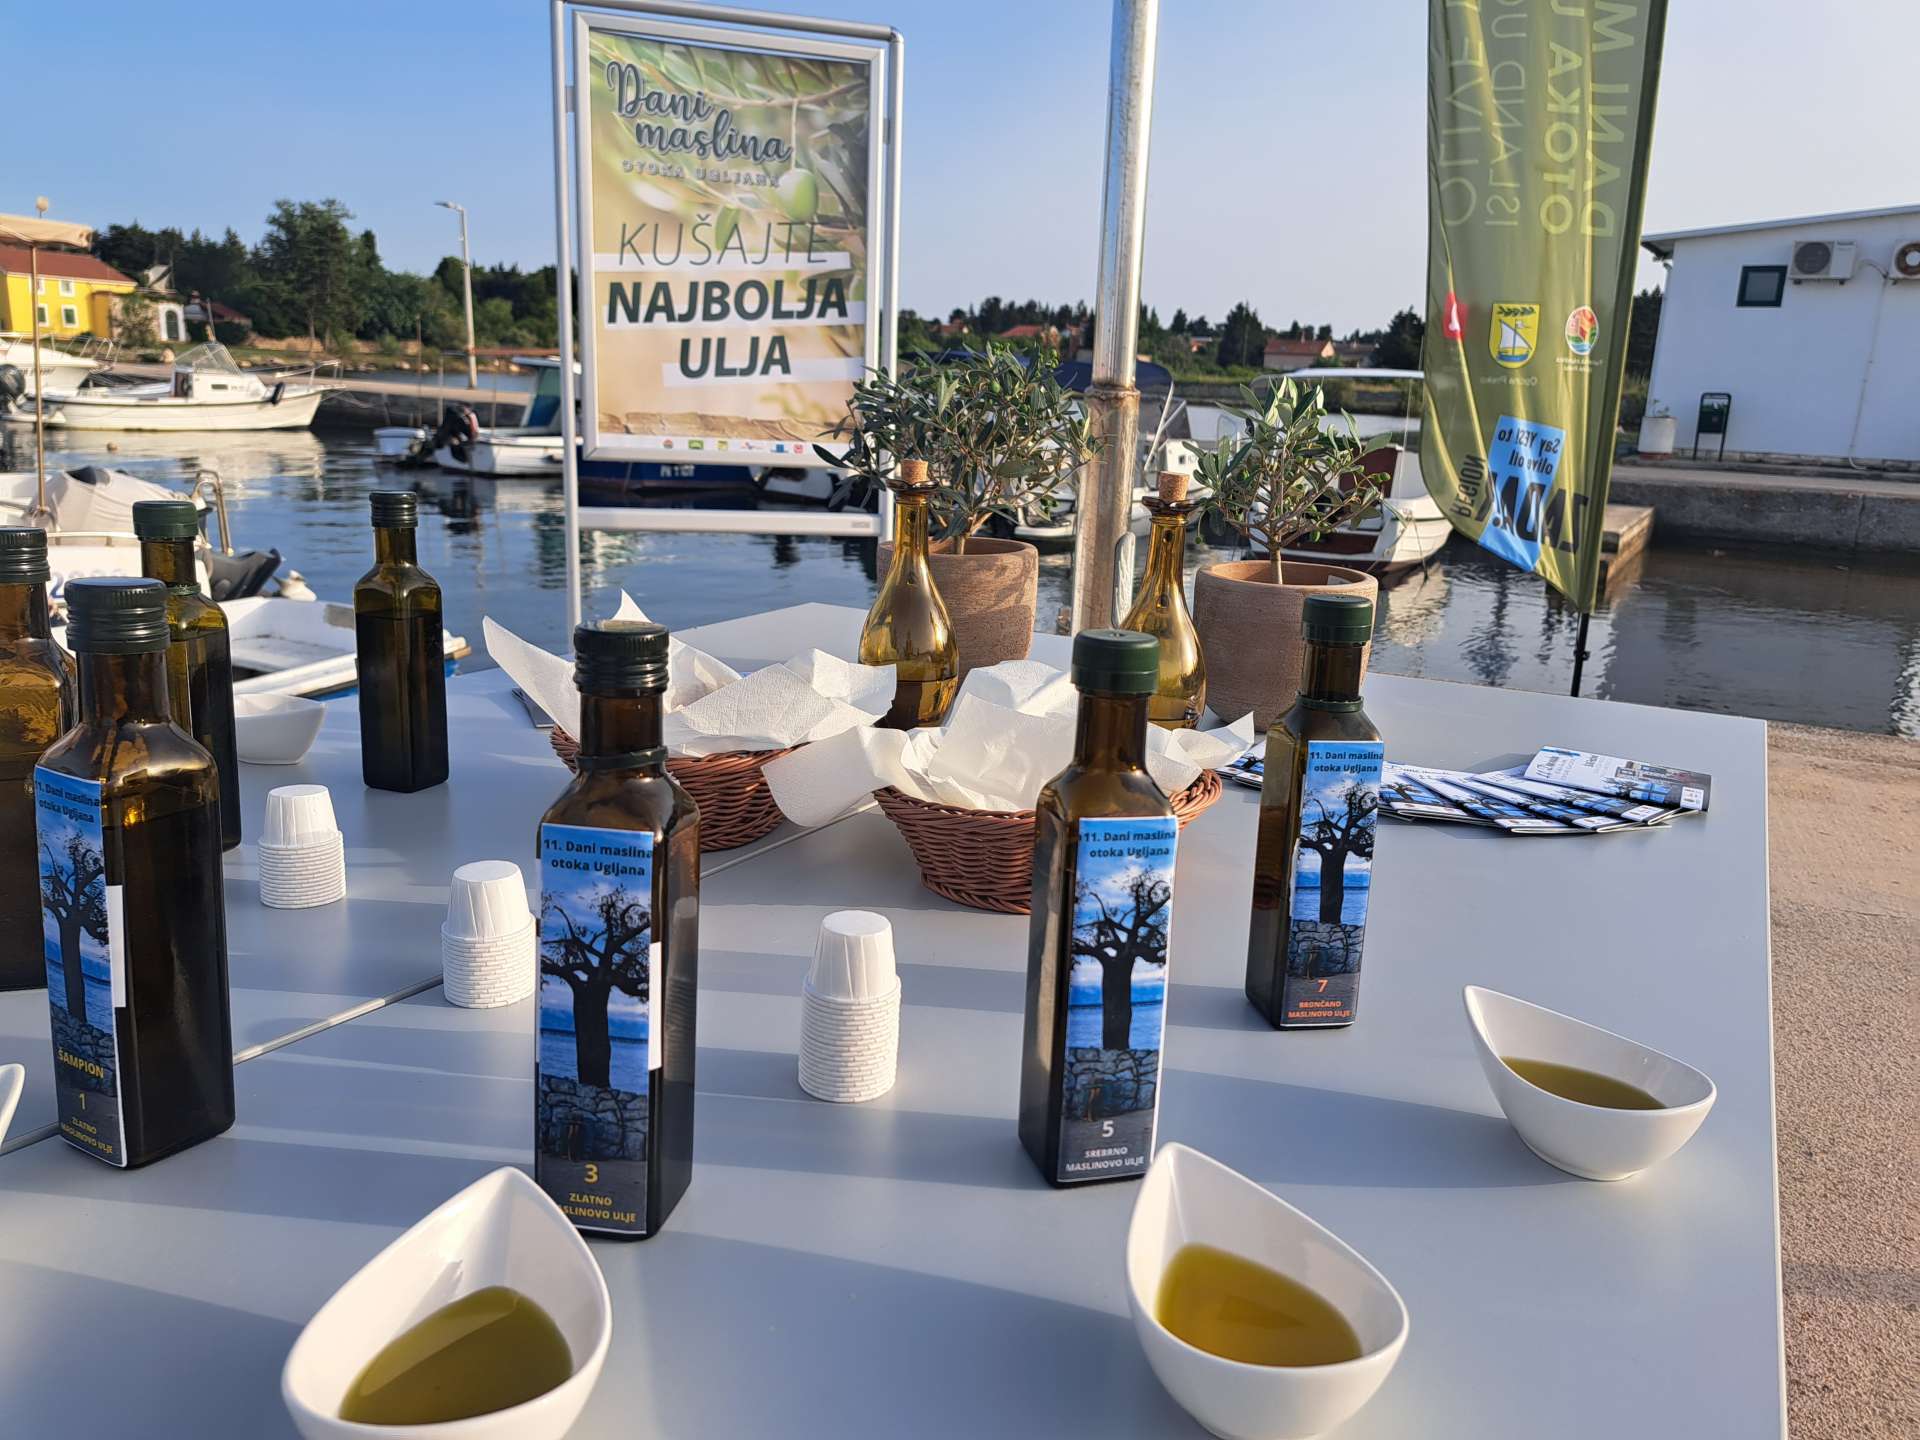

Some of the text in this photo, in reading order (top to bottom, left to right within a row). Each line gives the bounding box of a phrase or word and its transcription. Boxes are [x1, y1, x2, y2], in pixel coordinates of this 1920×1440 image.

[606, 61, 714, 123] Dani
[635, 109, 793, 162] maslina
[618, 214, 829, 266] KUŠAJTE
[607, 278, 849, 324] NAJBOLJA
[679, 335, 791, 379] ULJA
[1310, 751, 1384, 760] 11. Dani maslina
[1314, 763, 1378, 774] otoka Ugljana
[1084, 829, 1176, 842] 11. Dani maslina
[544, 839, 654, 859] 11. Dani maslina
[1089, 845, 1170, 859] otoka Ugljana
[551, 858, 646, 877] otoka Ugljana
[1317, 979, 1328, 993] 7
[58, 1046, 105, 1079] ŠAMPION
[79, 1092, 86, 1111] 1
[1101, 1120, 1114, 1138] 5
[583, 1163, 599, 1183] 3
[1065, 1158, 1123, 1172] MASLINOVO
[569, 1192, 613, 1206] ZLATNO
[559, 1204, 637, 1224] SLINOVO ULJE
